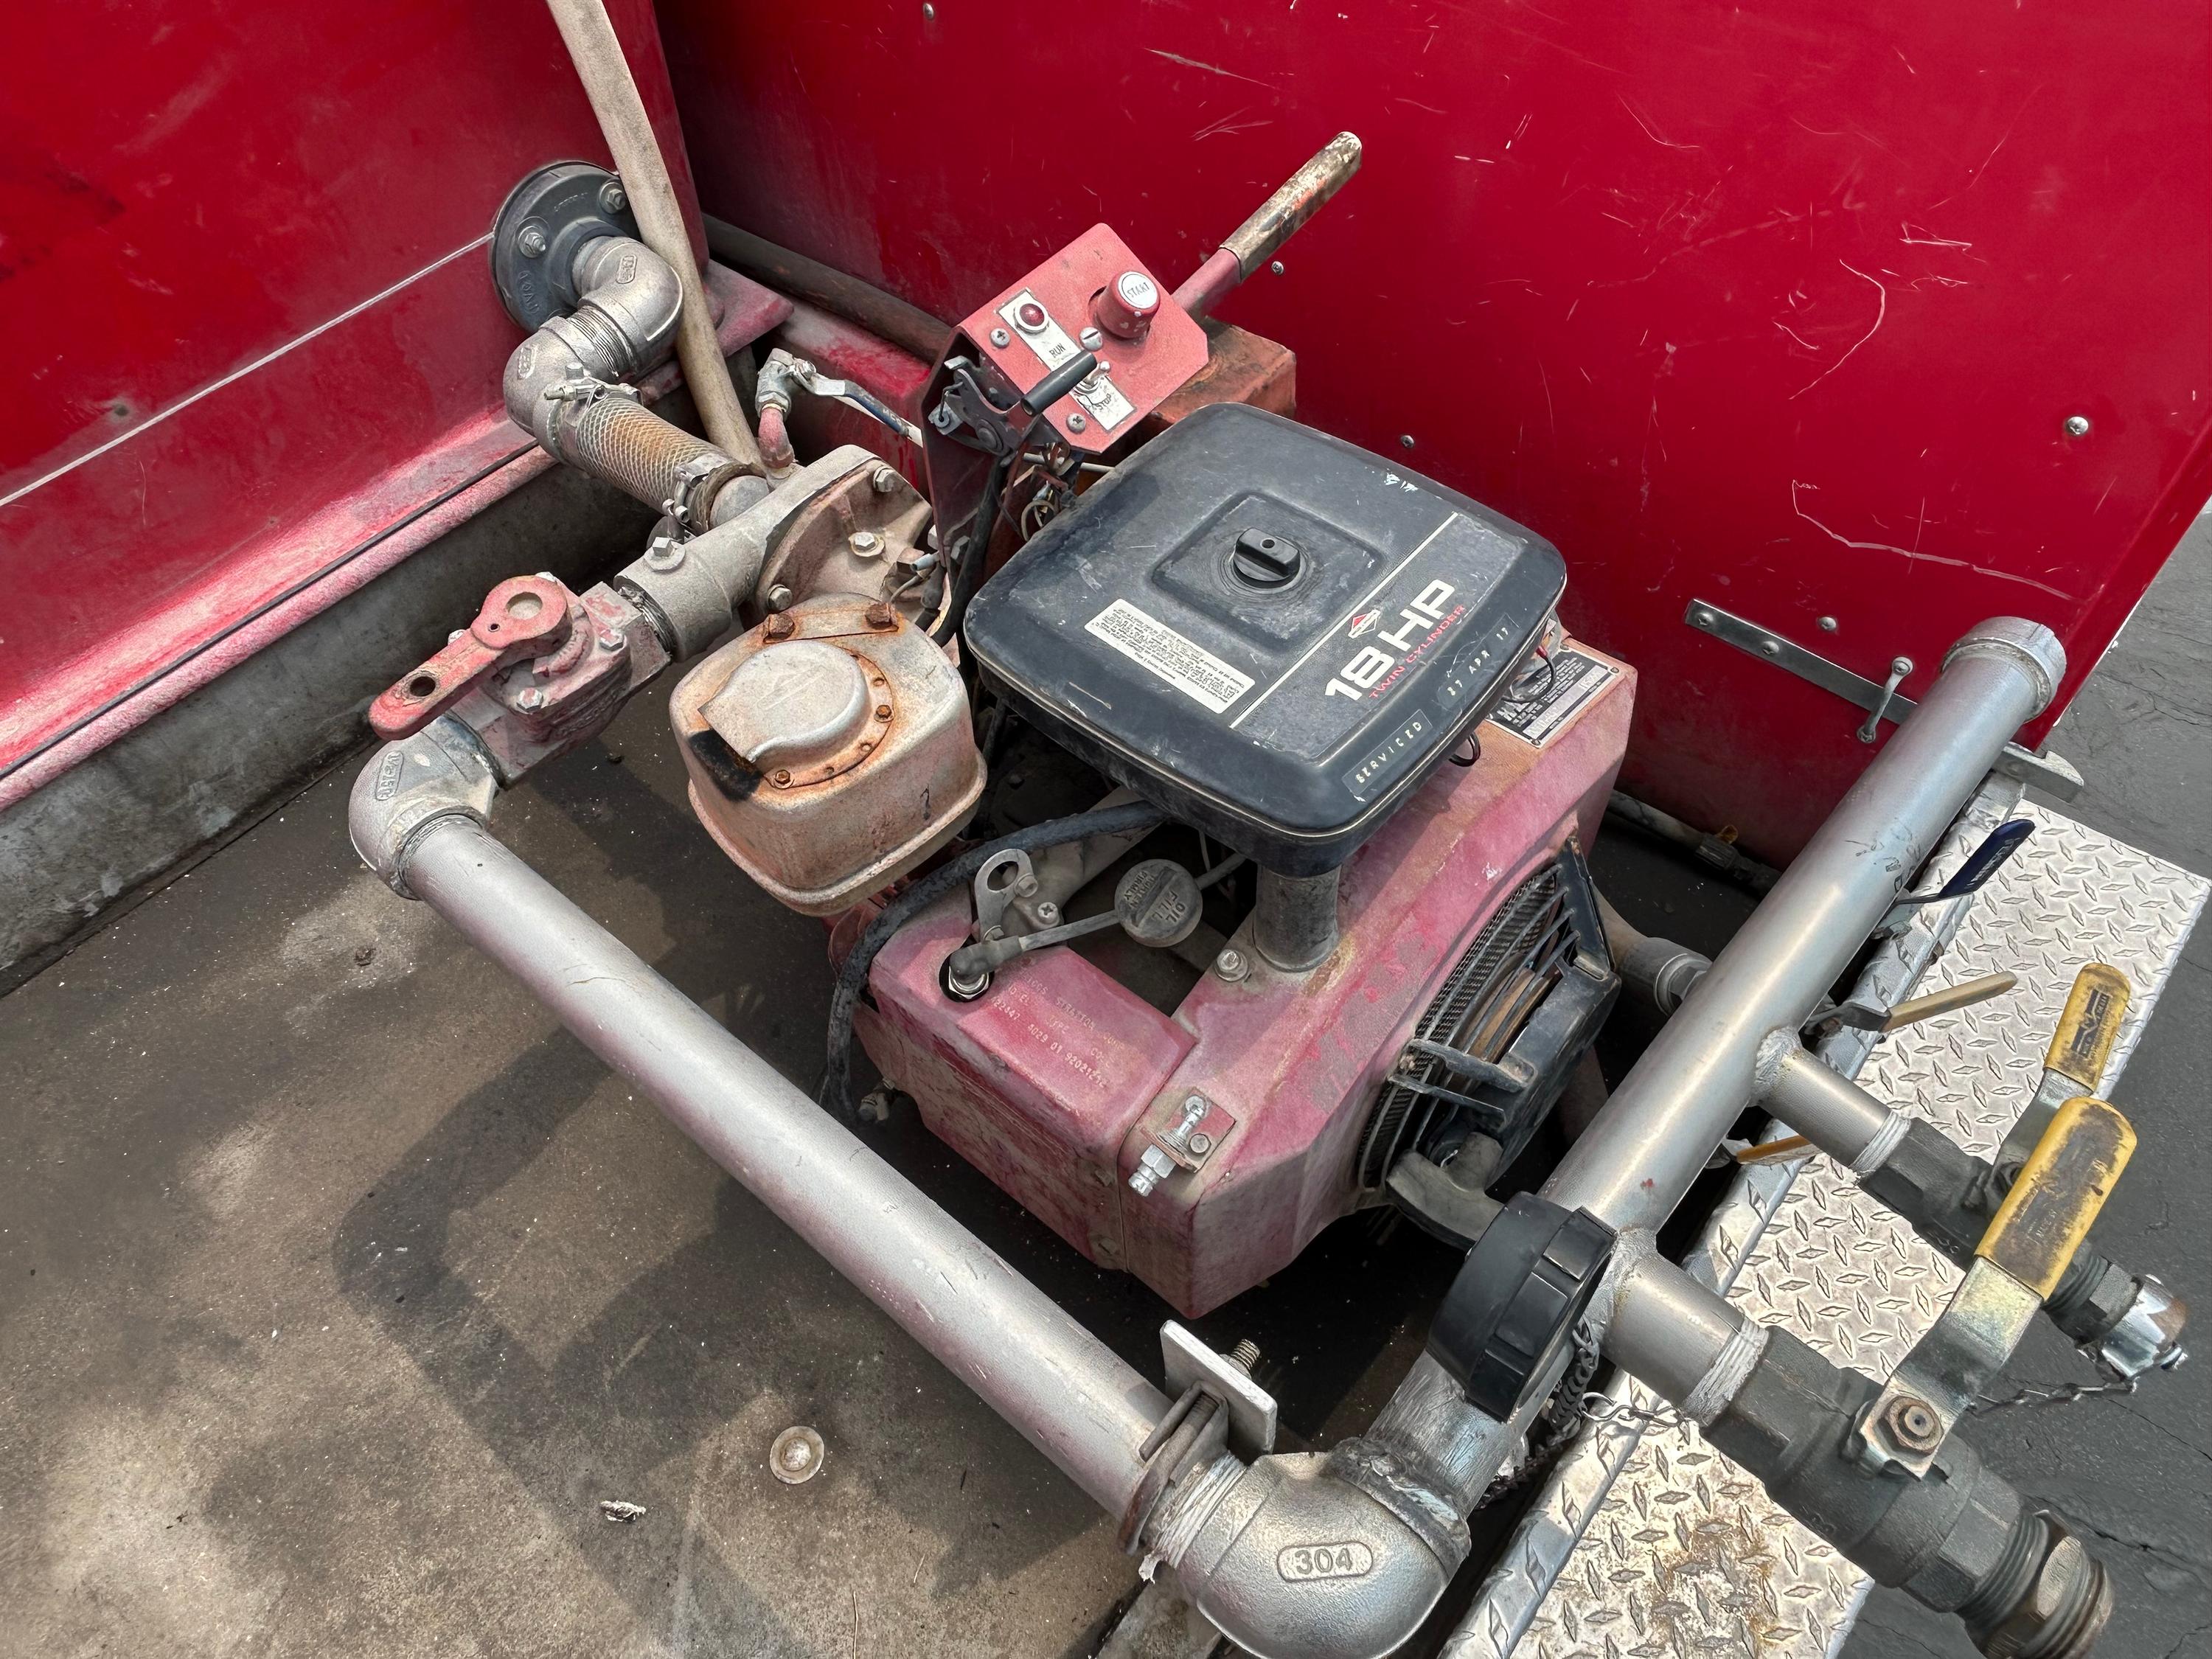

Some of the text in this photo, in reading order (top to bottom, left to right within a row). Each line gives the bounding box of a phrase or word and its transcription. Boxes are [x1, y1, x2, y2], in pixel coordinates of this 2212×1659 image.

[1127, 282, 1150, 299] START
[1048, 344, 1066, 360] RUN
[1095, 393, 1113, 411] STOP
[1325, 646, 1395, 700] 18
[1377, 580, 1455, 652] HP
[1369, 665, 1405, 699] TWIN
[1405, 605, 1466, 664] CYLINDER
[1468, 650, 1490, 675] APR
[1355, 721, 1422, 784] SERVICED
[1151, 890, 1178, 919] FILL
[1165, 902, 1186, 923] OIL
[1293, 1548, 1352, 1573] 304
